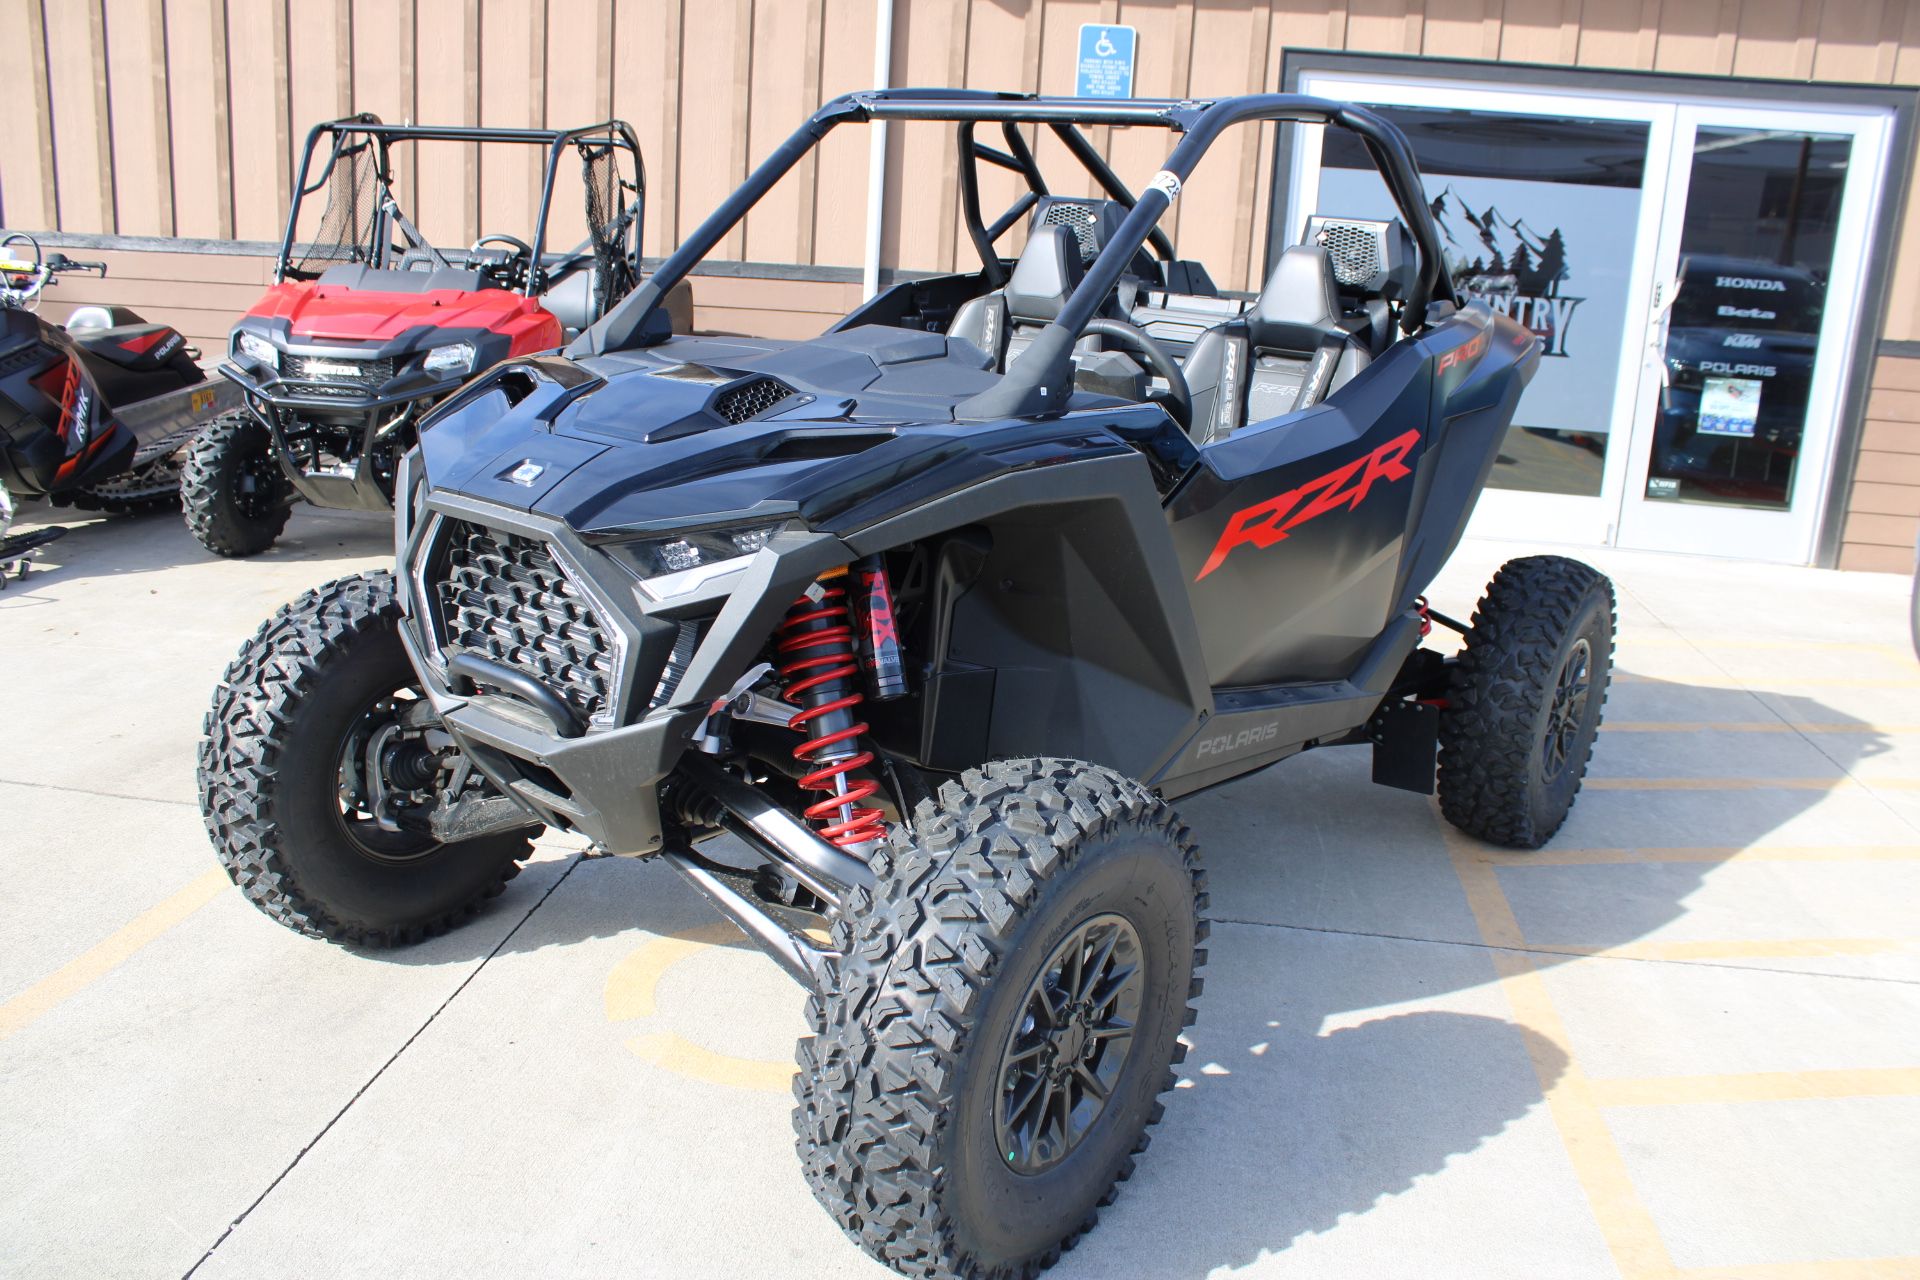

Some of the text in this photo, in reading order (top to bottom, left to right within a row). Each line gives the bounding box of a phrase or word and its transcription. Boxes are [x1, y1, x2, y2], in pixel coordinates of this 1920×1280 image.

[1716, 276, 1786, 291] HONDA
[1473, 292, 1577, 354] NTRY
[1717, 305, 1776, 319] Beta
[154, 333, 181, 360] POLARIS
[1437, 337, 1483, 377] PRO
[1722, 333, 1762, 349] KTM
[303, 363, 362, 377] NDA
[1225, 341, 1237, 380] RZR
[1699, 361, 1777, 377] POLARIS
[75, 387, 89, 443] RMK
[1194, 428, 1422, 583] RZR
[862, 570, 901, 649] FOX
[1196, 722, 1279, 759] POLARIS
